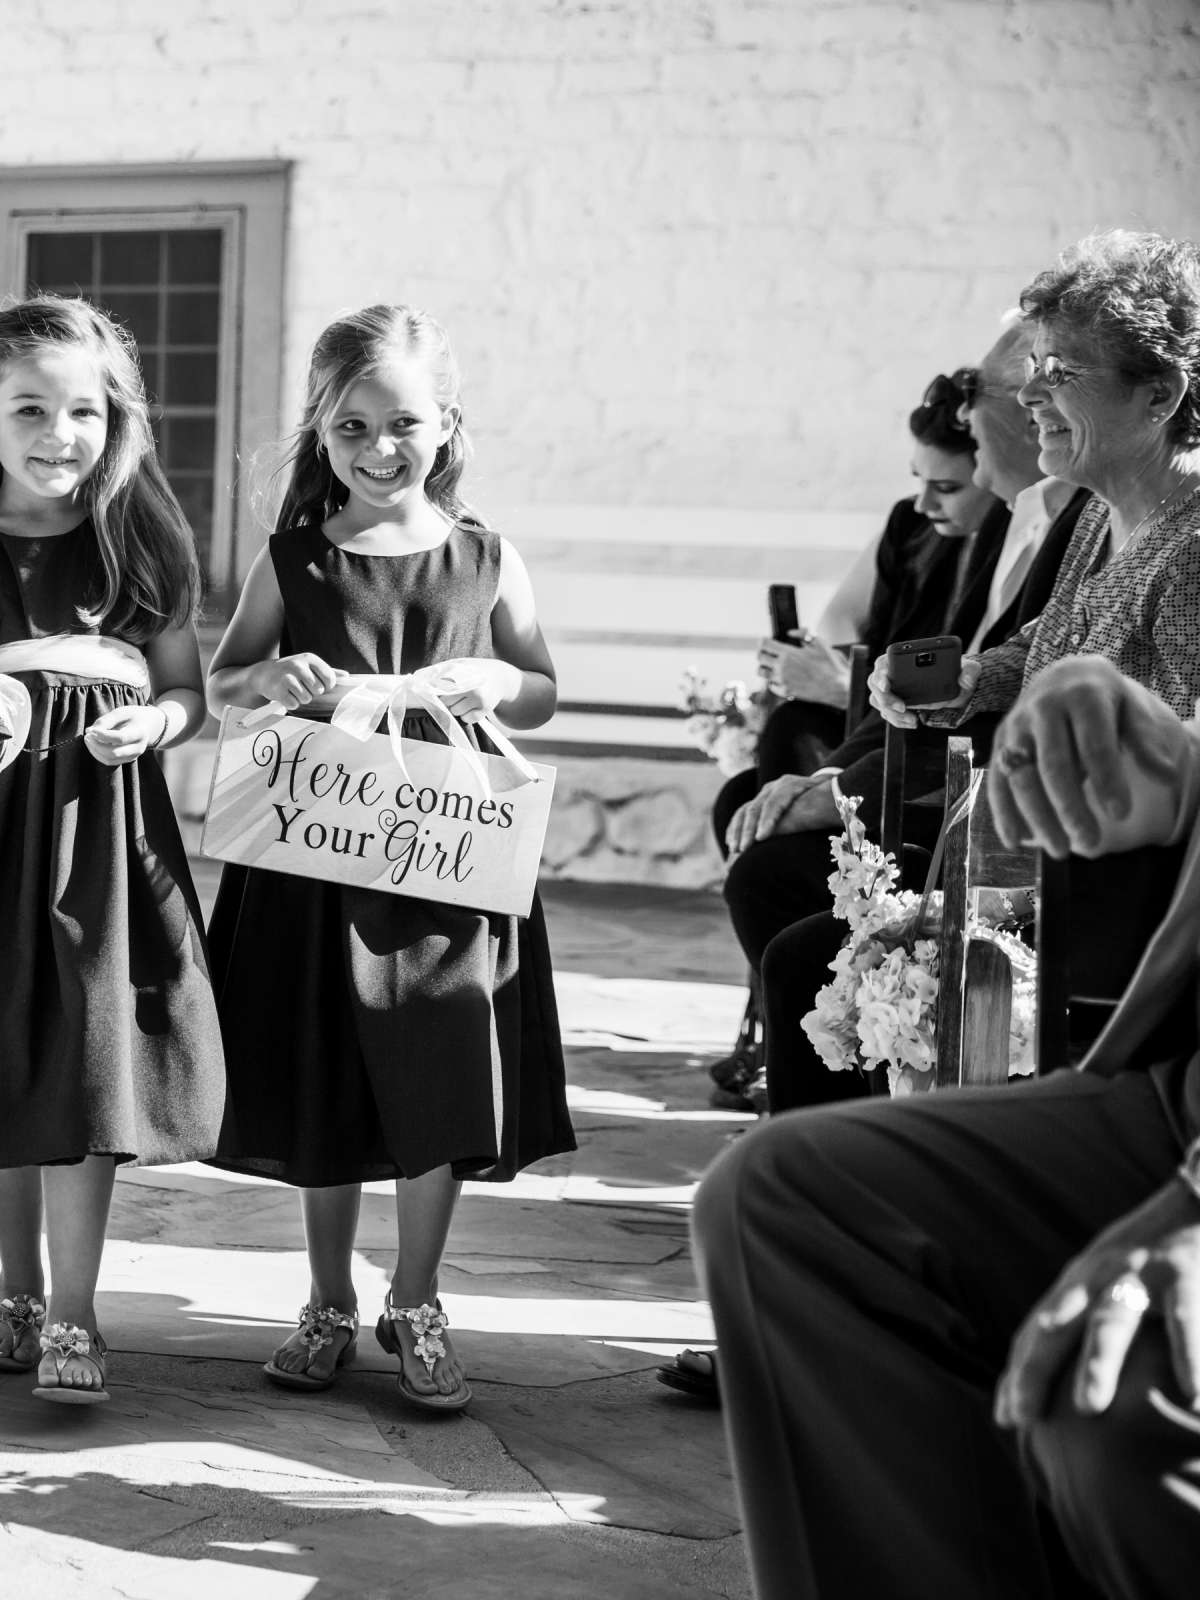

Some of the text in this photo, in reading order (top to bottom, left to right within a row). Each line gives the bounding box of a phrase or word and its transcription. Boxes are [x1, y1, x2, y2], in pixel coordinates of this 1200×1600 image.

[252, 729, 515, 829] Here comes
[272, 803, 474, 886] Your Girl
